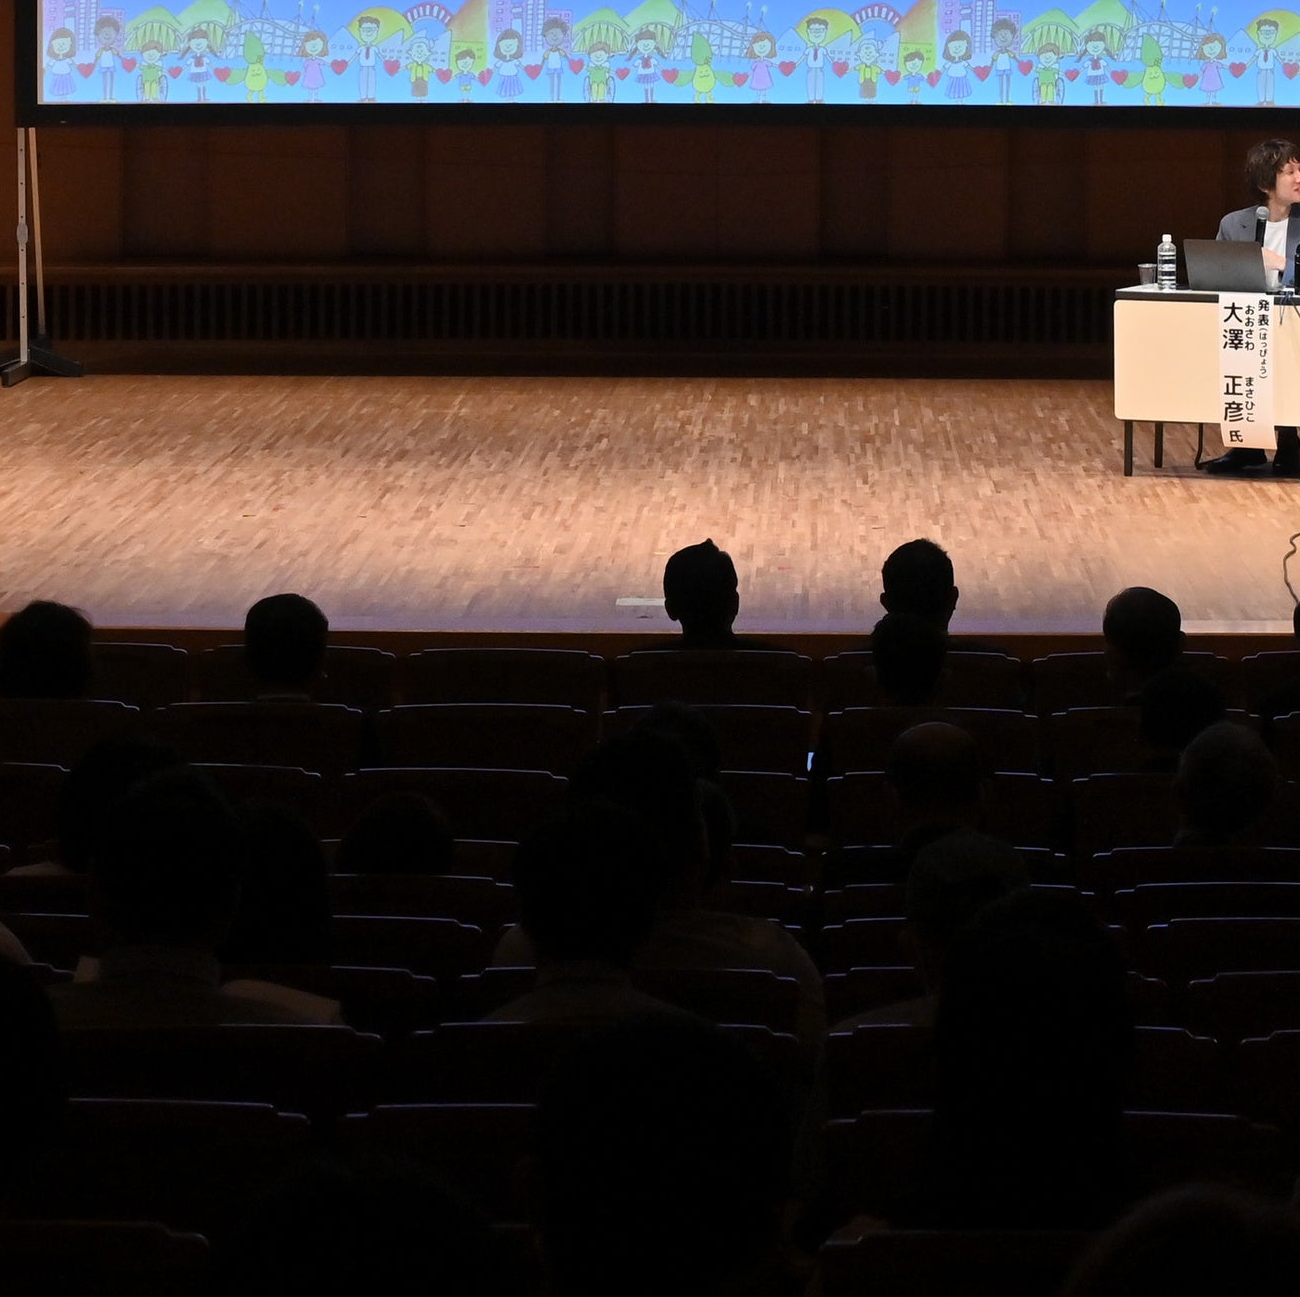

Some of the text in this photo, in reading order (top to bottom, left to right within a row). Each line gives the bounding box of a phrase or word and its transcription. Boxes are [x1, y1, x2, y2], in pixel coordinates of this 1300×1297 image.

[1223, 302, 1244, 350] 大澤
[1244, 305, 1256, 422] おおさわ まさひこ
